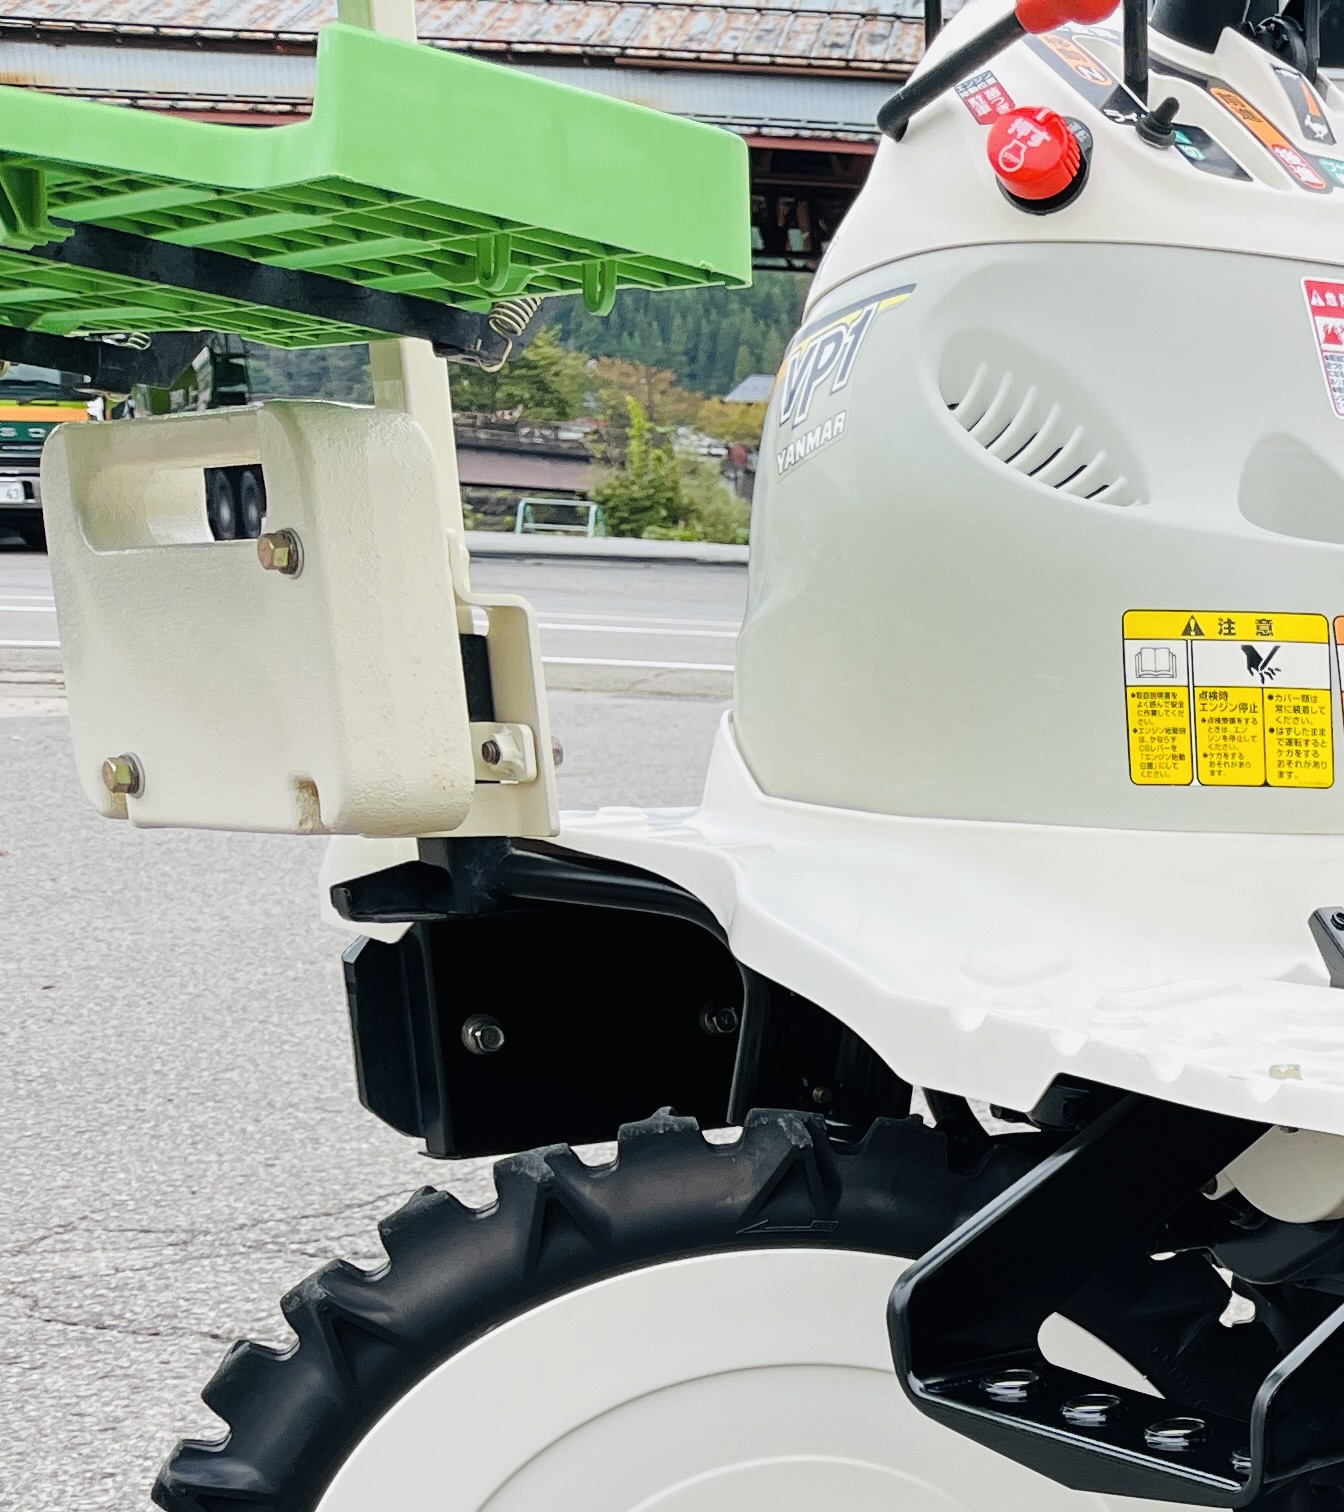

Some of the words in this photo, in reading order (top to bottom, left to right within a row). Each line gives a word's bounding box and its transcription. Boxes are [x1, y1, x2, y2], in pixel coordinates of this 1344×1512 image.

[1007, 118, 1051, 148] 押す
[779, 301, 881, 430] VP1
[776, 411, 847, 476] YANMAR
[1218, 618, 1274, 637] 注意
[1199, 691, 1228, 702] 点検時
[1275, 694, 1318, 703] カバー類は
[1199, 703, 1258, 714] エンジン停止
[1276, 727, 1326, 736] はずしたまま
[1276, 738, 1327, 748] で運転すると
[1277, 750, 1319, 758] ケガをする
[1277, 760, 1327, 769] おそれがあり
